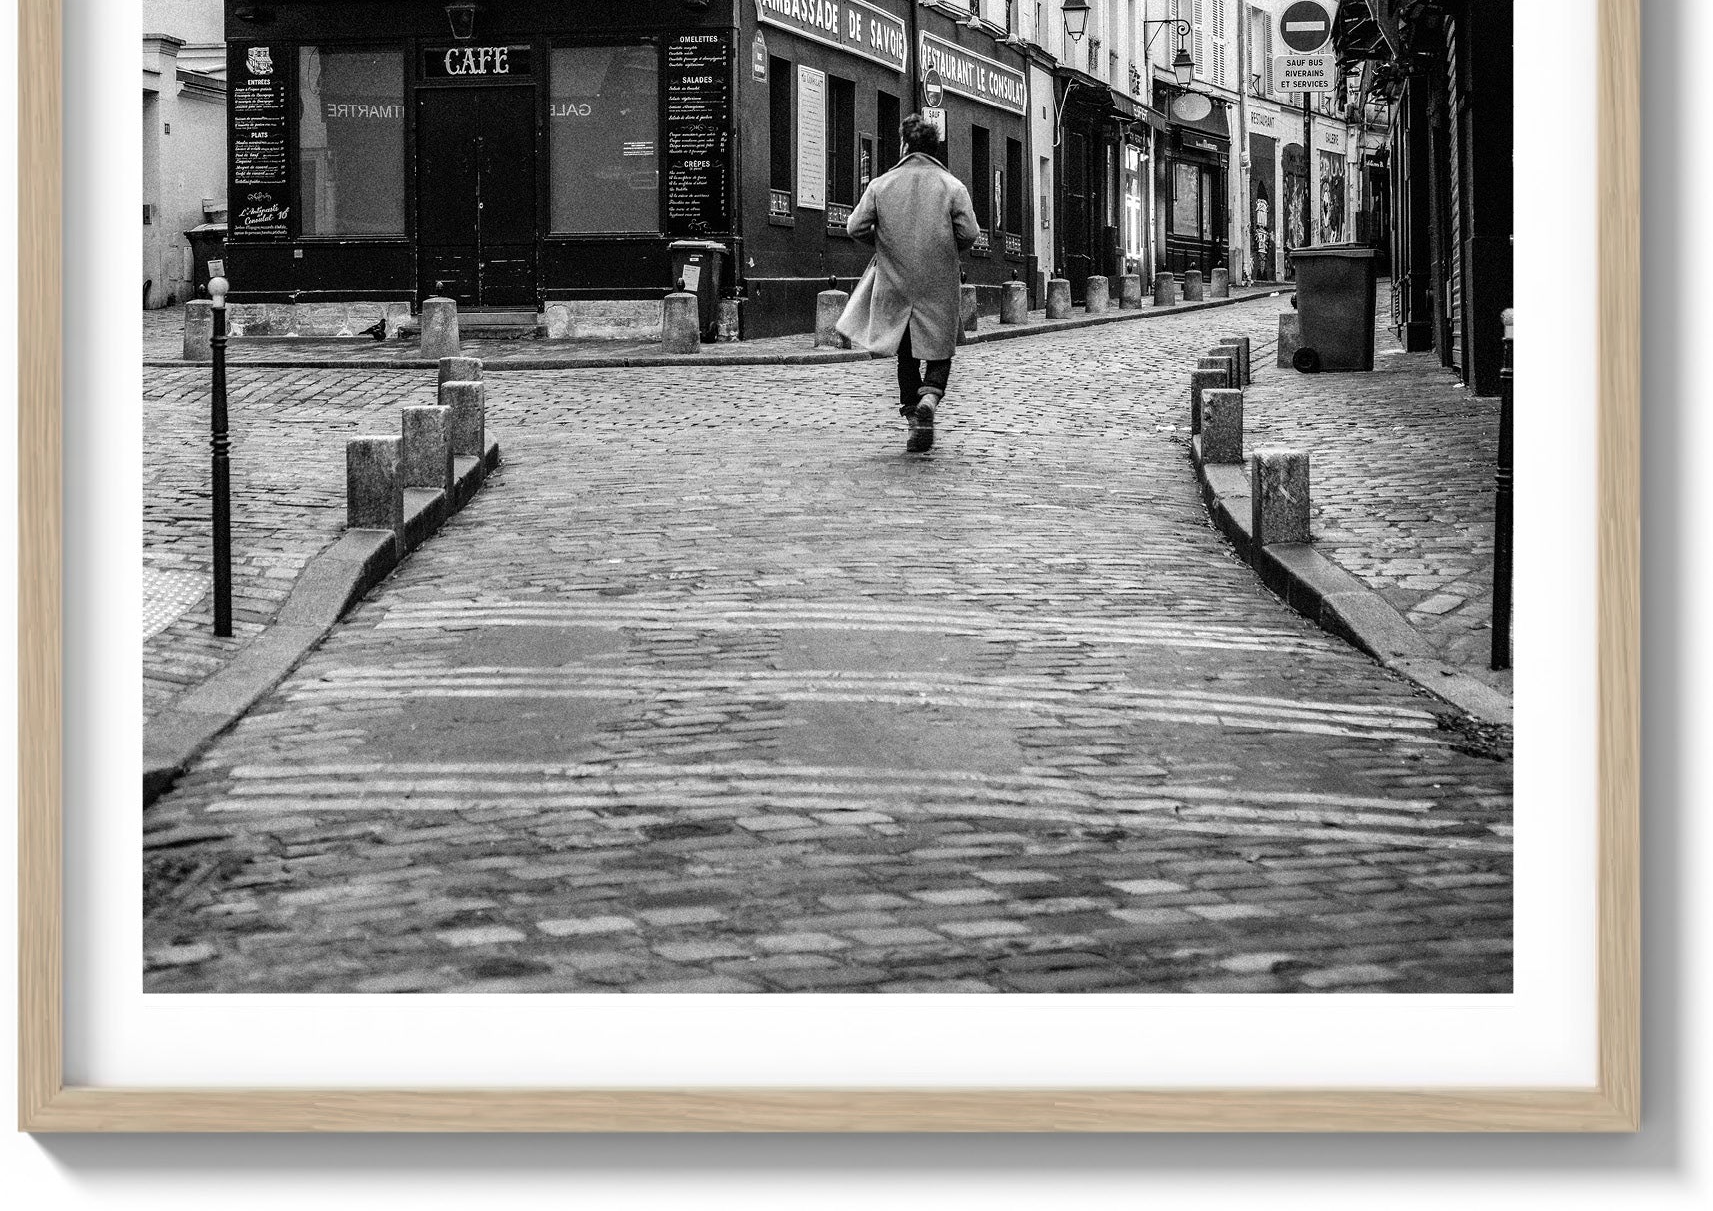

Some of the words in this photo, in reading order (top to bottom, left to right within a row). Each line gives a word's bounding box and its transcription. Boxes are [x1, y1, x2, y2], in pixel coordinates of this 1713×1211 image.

[849, 9, 861, 42] DE
[870, 19, 903, 60] SAVOIE
[680, 35, 718, 43] OMELETTES
[1286, 59, 1306, 67] SAUF
[922, 43, 975, 87] RESTAURANT
[976, 66, 986, 92] LE
[989, 71, 1023, 106] CONSULAT
[682, 76, 713, 84] SALADES
[1293, 80, 1329, 88] SERVICES
